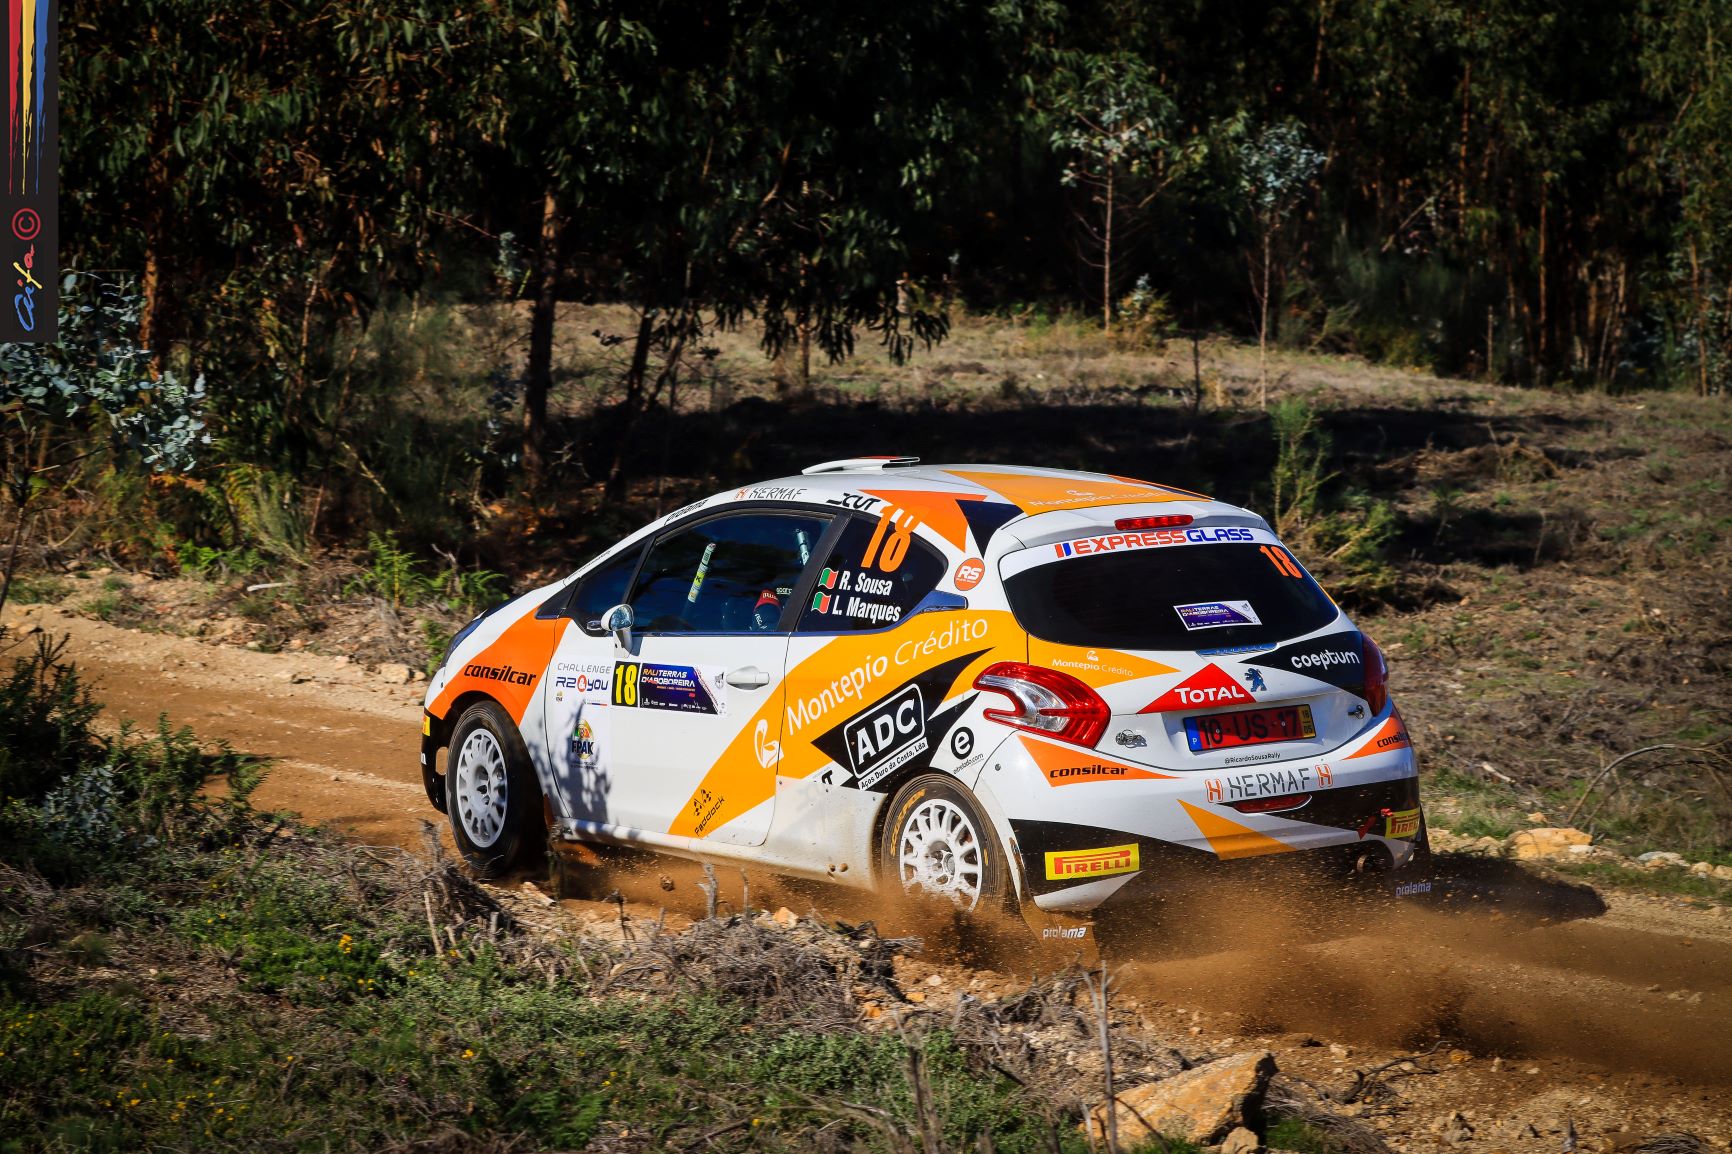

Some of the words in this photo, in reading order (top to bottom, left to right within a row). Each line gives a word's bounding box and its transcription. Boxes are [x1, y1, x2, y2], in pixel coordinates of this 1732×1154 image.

[750, 487, 807, 500] HERMAF
[861, 503, 931, 573] 18
[1258, 544, 1303, 579] 18
[838, 570, 851, 591] R.
[855, 572, 893, 596] Sousa
[957, 565, 982, 580] RS
[832, 595, 843, 616] L.
[846, 596, 901, 624] Marques
[558, 663, 611, 674] CHALLENGE
[1052, 659, 1100, 671] Montepio
[1101, 664, 1134, 677] Crédito
[1291, 649, 1360, 670] coeptum
[464, 664, 536, 686] consilcar
[615, 664, 637, 706] 18
[786, 655, 889, 736] Montepio
[894, 618, 988, 665] Crédito
[1174, 685, 1245, 705] TOTAL
[856, 698, 917, 766] ADC
[572, 740, 594, 755] FPAK
[1225, 752, 1280, 764] @RicardoSousaRally
[861, 776, 875, 789] Aços
[875, 767, 888, 779] Duro
[889, 762, 896, 770] da
[914, 742, 926, 752] Lda
[1050, 764, 1128, 778] consilcar
[1227, 768, 1310, 799] HERMAF
[1053, 850, 1131, 875] PIRELLI
[1396, 882, 1432, 897] prolama
[1043, 926, 1086, 940] prolama
